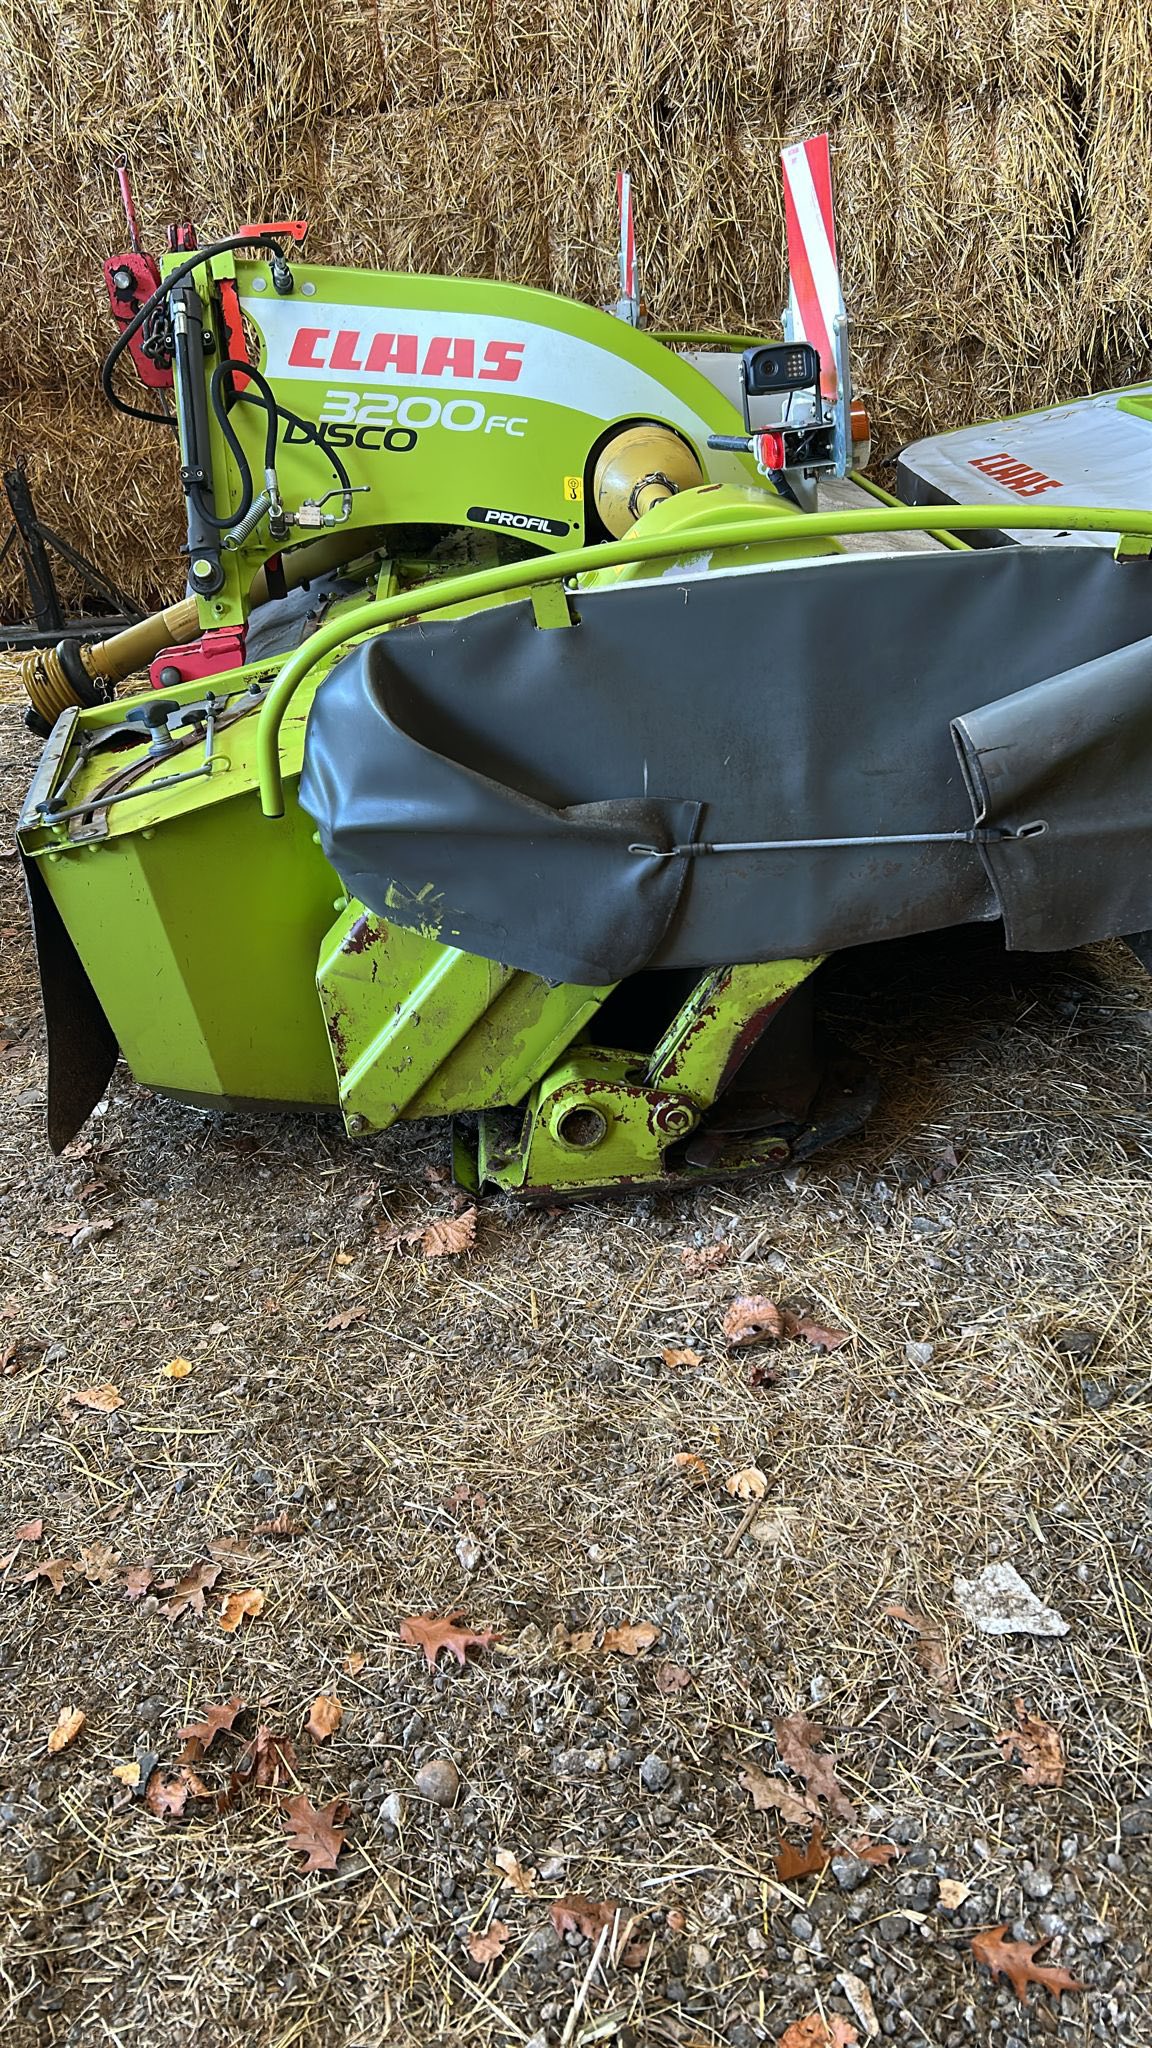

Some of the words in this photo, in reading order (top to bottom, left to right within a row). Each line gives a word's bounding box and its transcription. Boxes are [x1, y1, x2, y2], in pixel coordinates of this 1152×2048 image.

[288, 327, 525, 382] CLAAS
[282, 420, 418, 452] DISCO
[967, 452, 1064, 497] CLAAS
[484, 510, 552, 533] PROFIL
